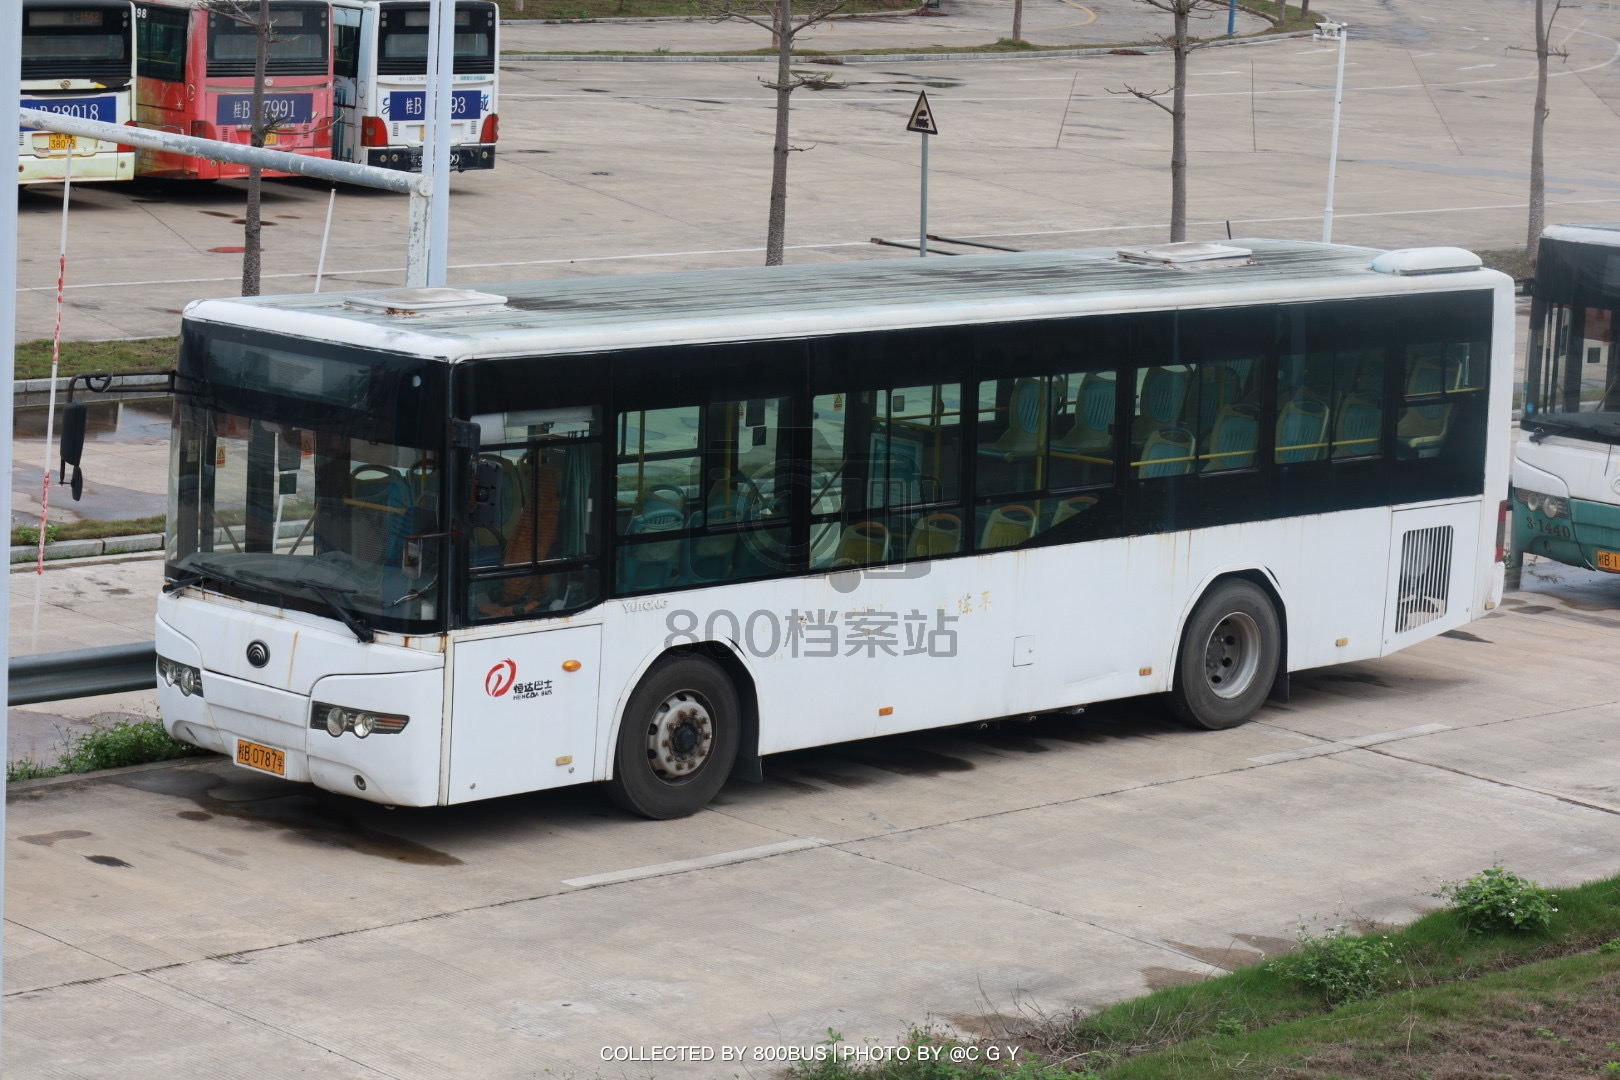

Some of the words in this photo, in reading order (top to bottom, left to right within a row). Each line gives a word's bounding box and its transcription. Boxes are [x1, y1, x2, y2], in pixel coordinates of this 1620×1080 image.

[622, 599, 669, 613] YUTONG
[513, 679, 553, 694] 恒达巴士
